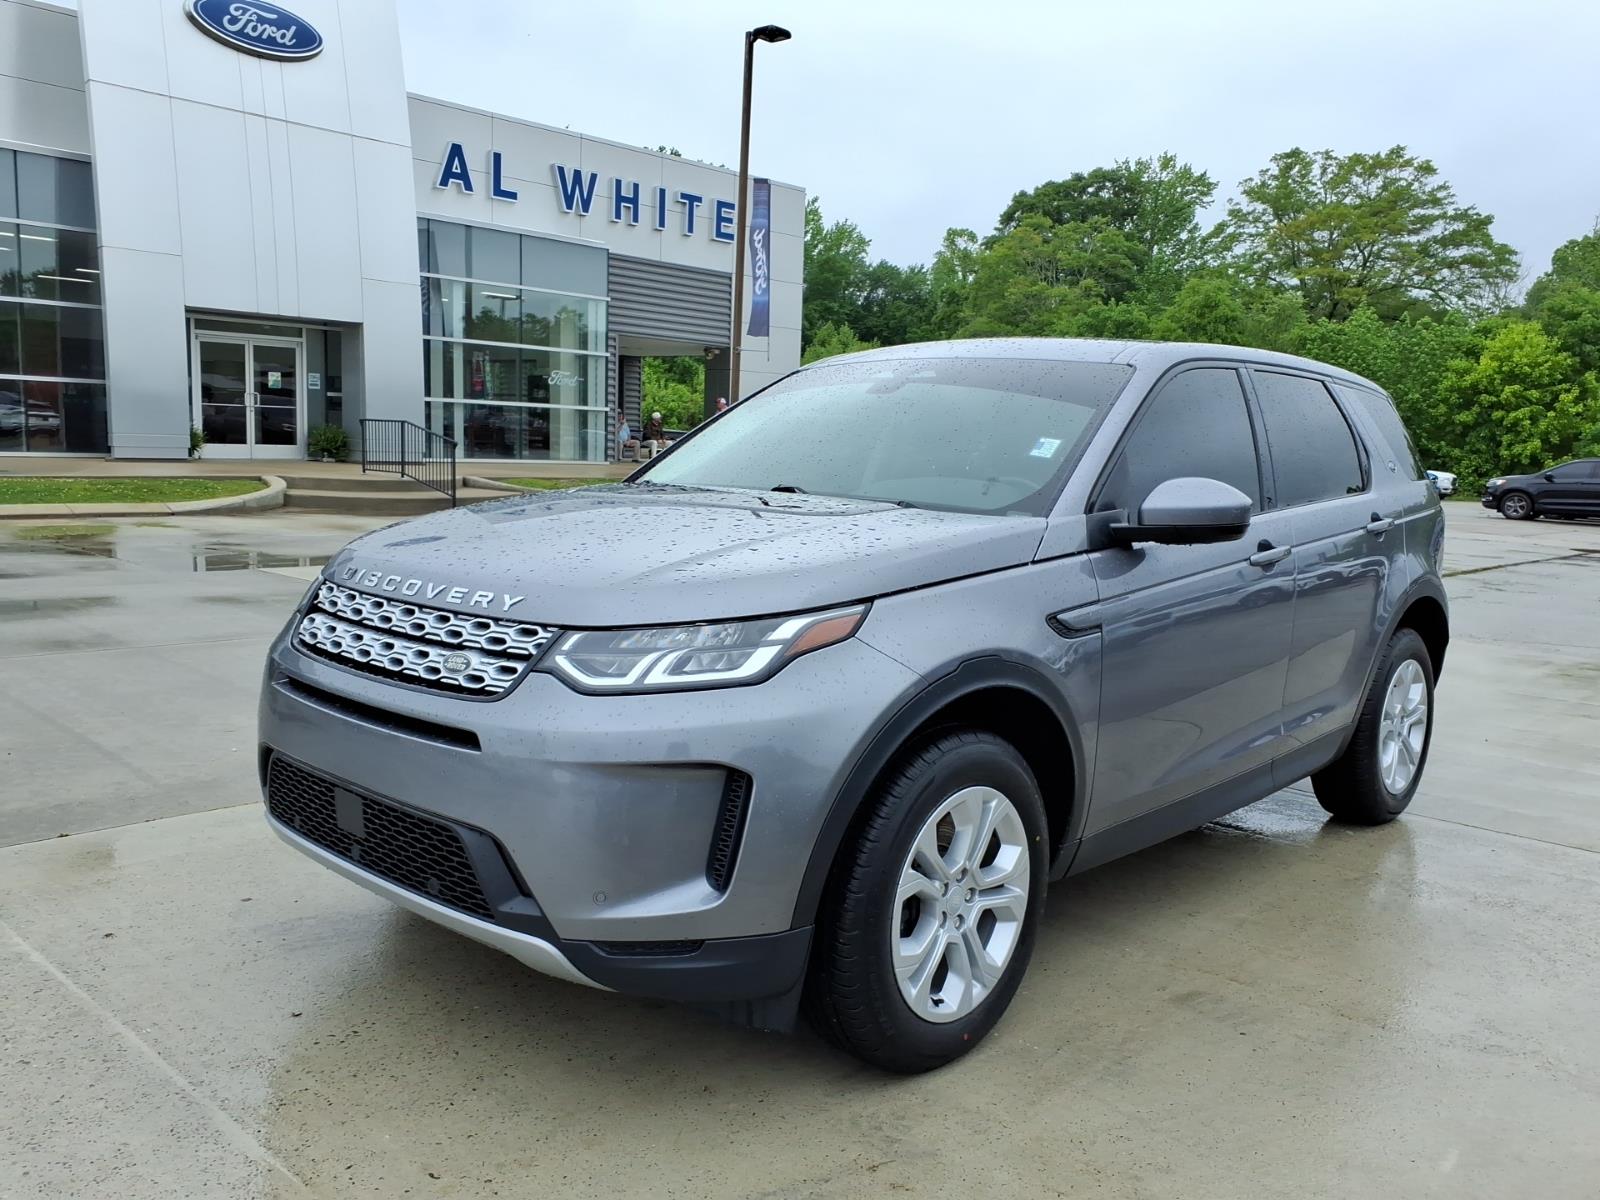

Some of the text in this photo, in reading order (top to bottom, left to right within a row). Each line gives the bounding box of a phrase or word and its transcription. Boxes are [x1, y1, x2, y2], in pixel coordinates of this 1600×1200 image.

[222, 3, 297, 46] Ford
[436, 141, 737, 244] AL WHITE
[342, 566, 526, 612] DISCOVERY
